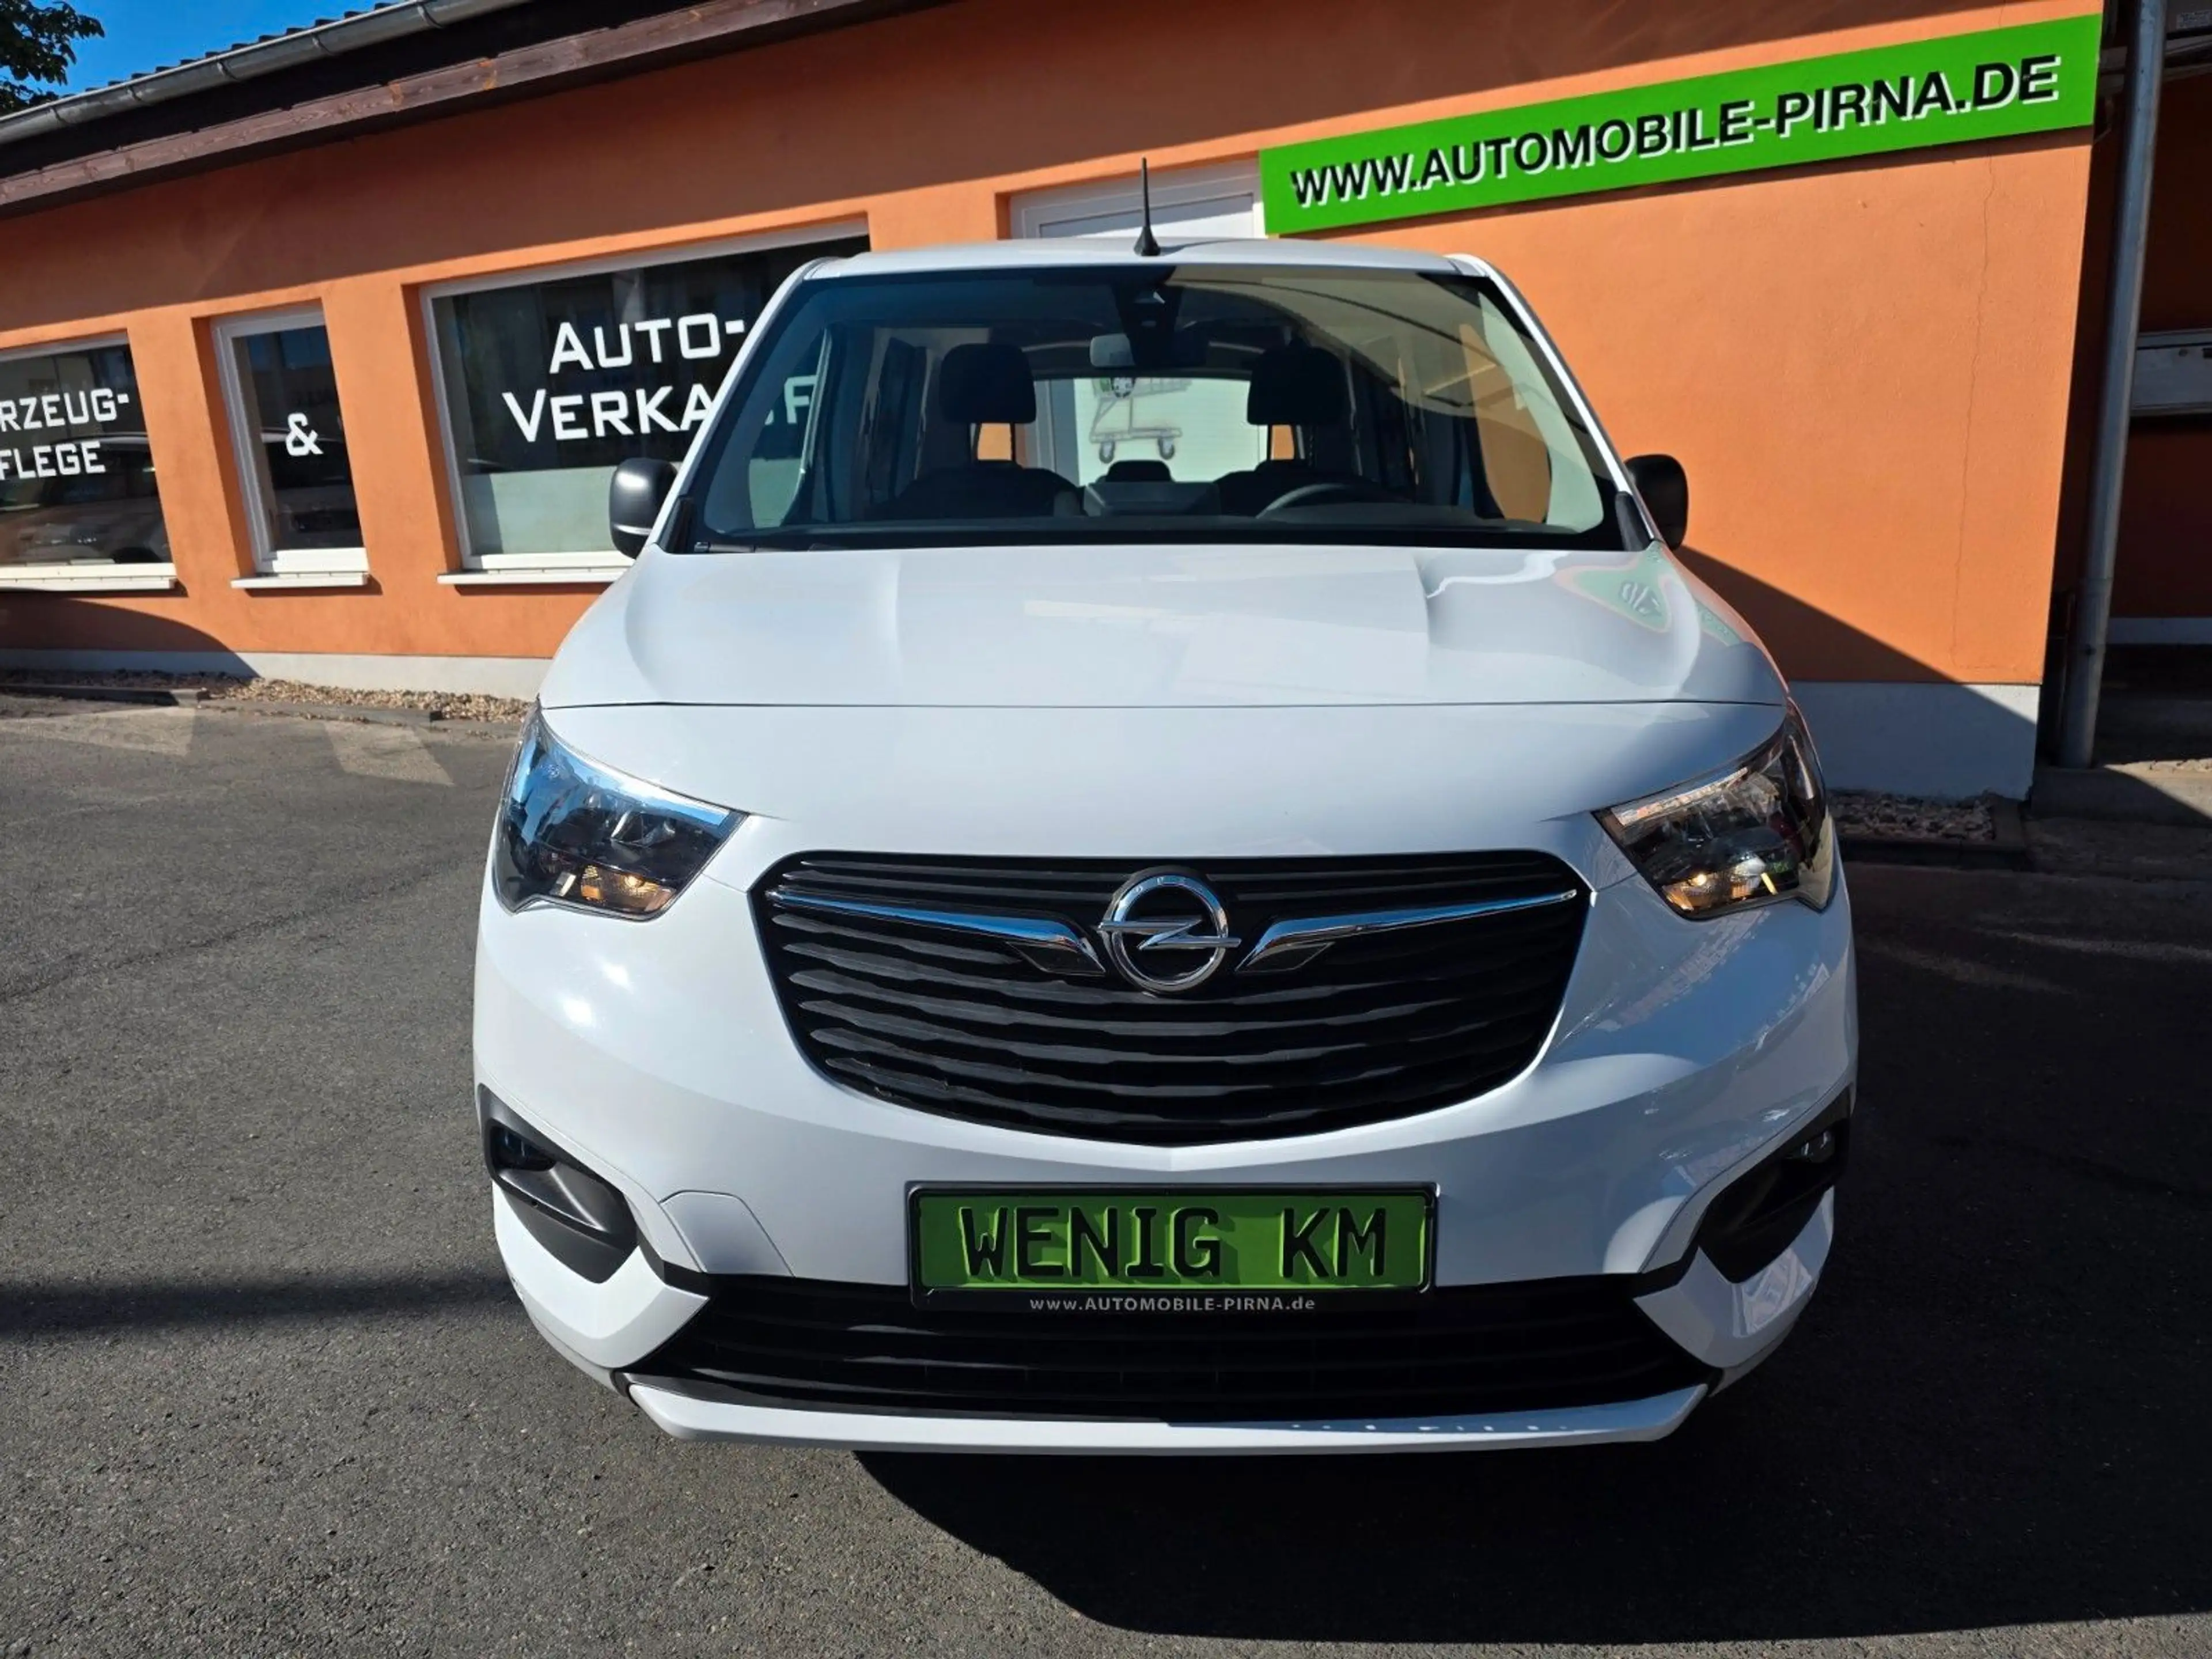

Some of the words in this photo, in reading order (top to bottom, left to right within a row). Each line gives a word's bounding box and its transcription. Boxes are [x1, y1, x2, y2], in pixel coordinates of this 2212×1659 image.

[1290, 54, 2062, 209] WWW.AUTOMOBILE-PIRNA.DE
[549, 312, 745, 374] AUTO-
[285, 412, 324, 456] &
[502, 374, 818, 443] VERKAF
[957, 1206, 1222, 1278] WENIG
[1278, 1206, 1387, 1279] KM
[1029, 1296, 1316, 1312] www.AUTOMOBILE-PIRNA.de
